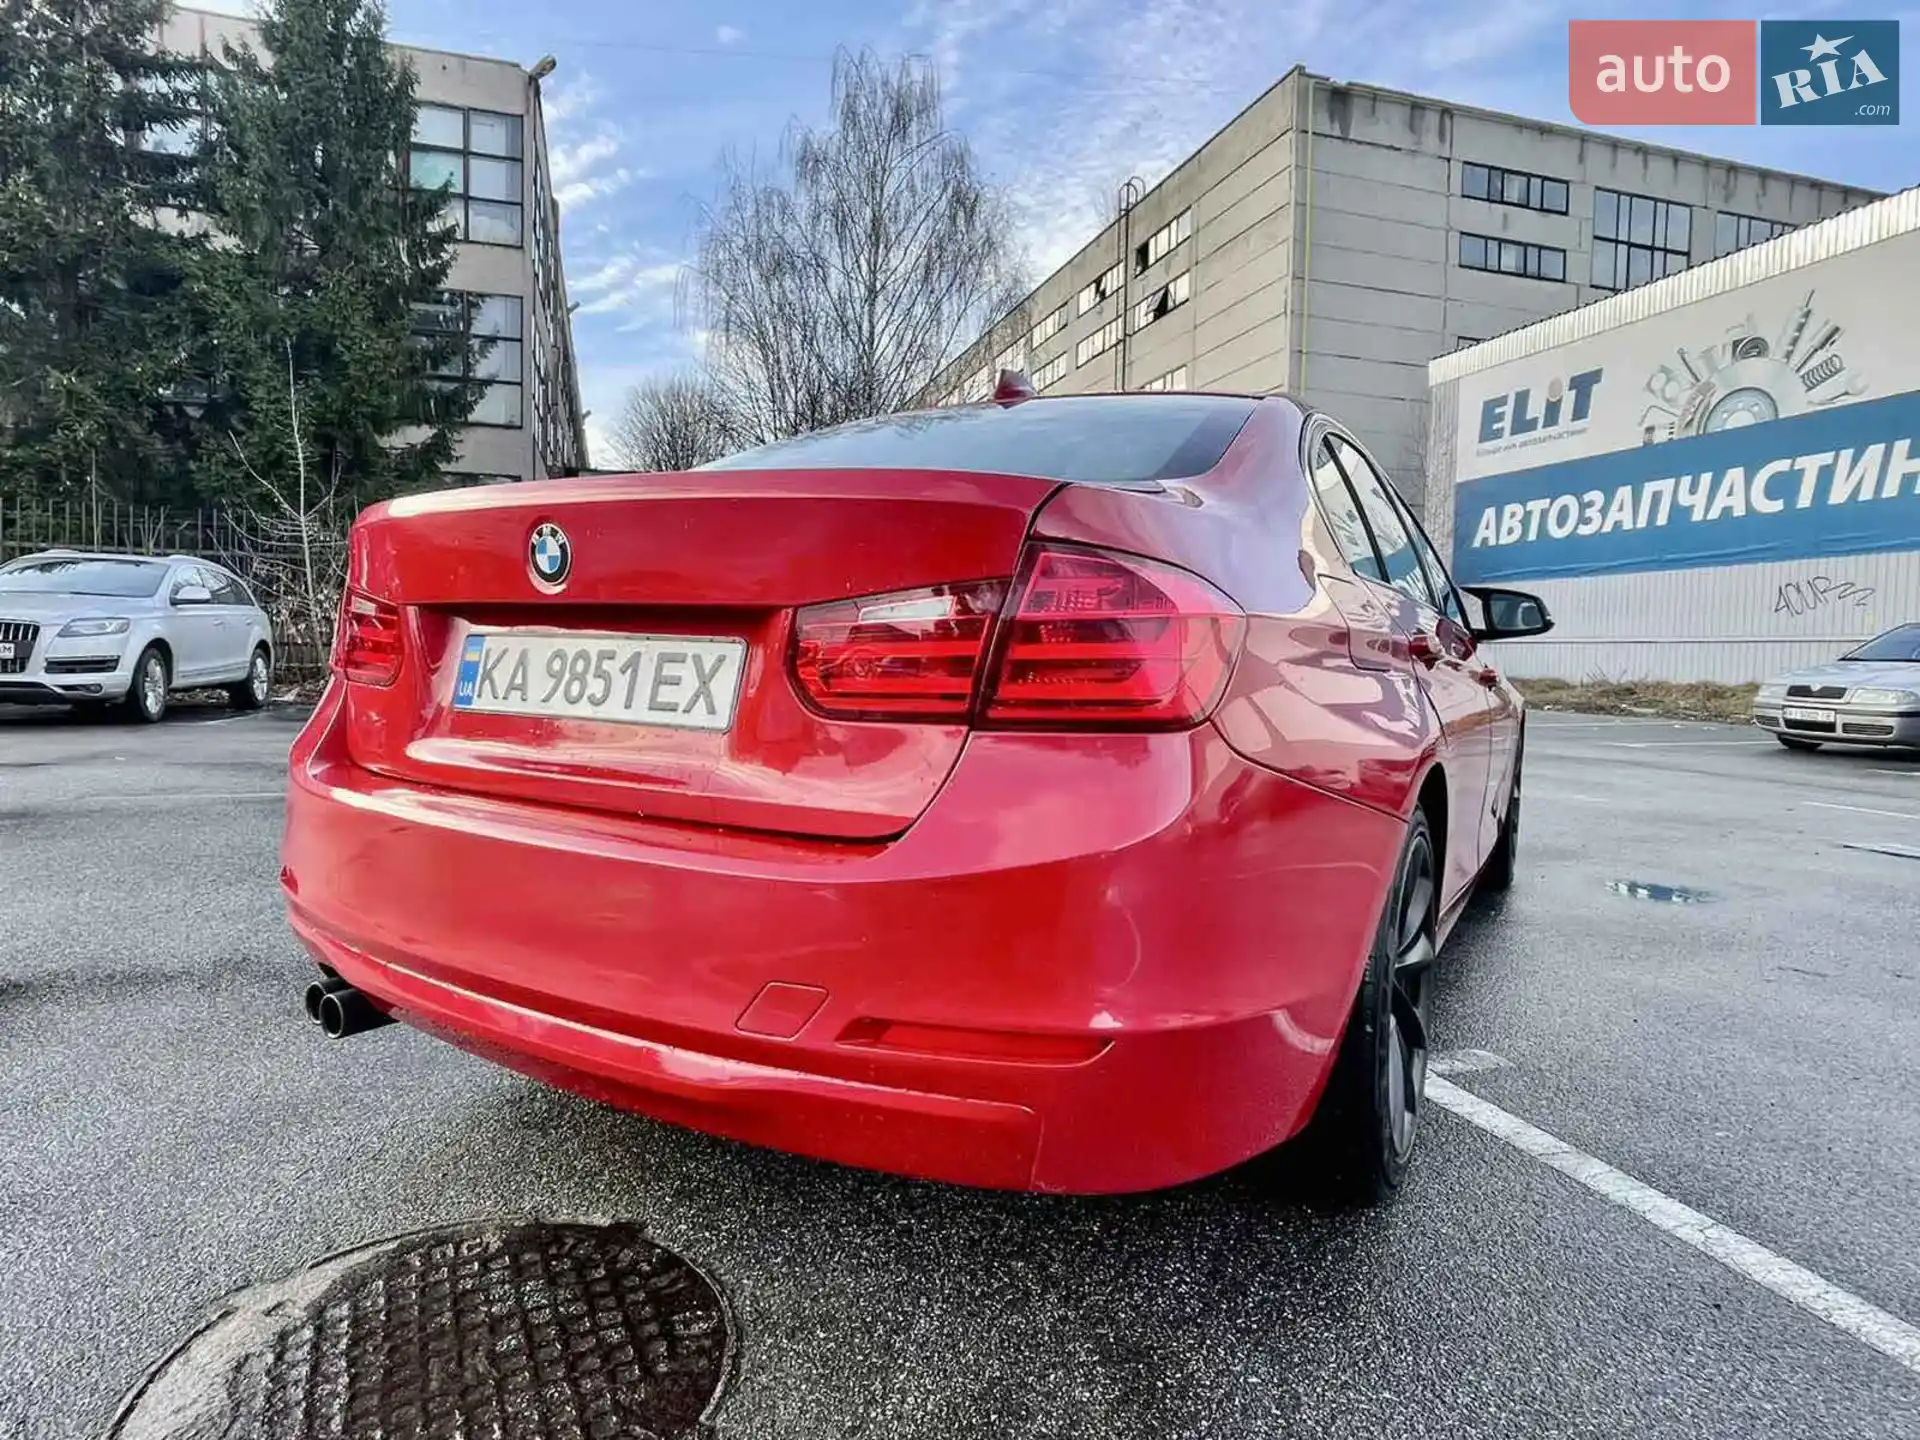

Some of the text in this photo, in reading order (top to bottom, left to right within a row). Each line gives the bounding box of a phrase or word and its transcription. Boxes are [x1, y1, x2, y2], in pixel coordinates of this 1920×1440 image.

[531, 525, 566, 546] BMW
[458, 680, 474, 697] UA
[477, 647, 727, 716] KA 9851 EX
